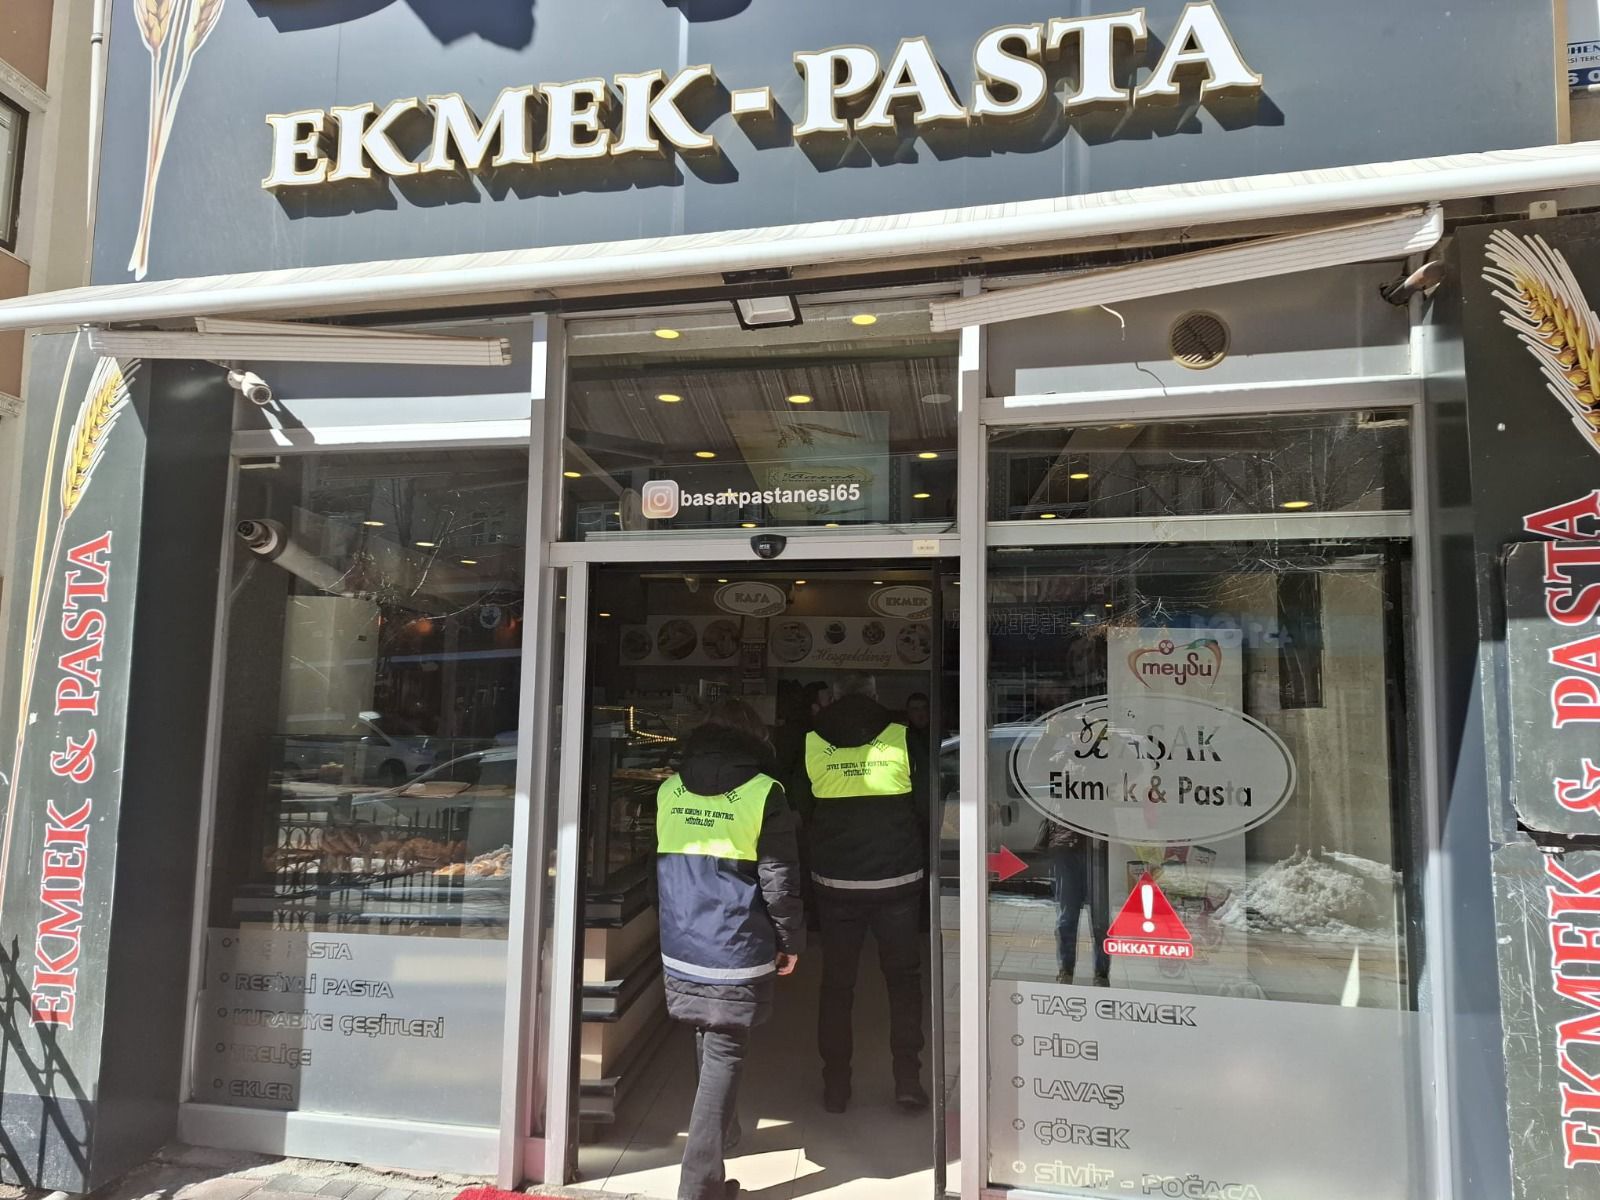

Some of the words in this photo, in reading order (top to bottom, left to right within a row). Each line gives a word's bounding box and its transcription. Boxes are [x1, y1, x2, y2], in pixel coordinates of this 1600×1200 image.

[261, 64, 714, 188] EKMEK
[793, 2, 1263, 137] PASTA
[681, 484, 860, 508] basakpastanesi65
[885, 596, 928, 607] EKMEK
[1522, 489, 1600, 729] PASTA
[54, 531, 112, 717] PASTA
[50, 729, 97, 784] &
[1147, 776, 1168, 804] &
[1178, 776, 1252, 807] Pasta
[29, 798, 92, 1031] EKMEK
[1108, 940, 1155, 955] DİKKAT
[1160, 944, 1189, 957] KAPI
[323, 978, 394, 999] PASTA
[232, 1007, 333, 1031] KURABİYE
[339, 1013, 444, 1039] ÇEŞİTLERİ
[1031, 994, 1087, 1022] TAŞ
[1095, 999, 1197, 1027] EKMEK
[1544, 854, 1600, 1169] EKMEK
[1033, 1033, 1098, 1061] PİDE
[229, 1080, 293, 1101] EKLER
[1033, 1078, 1124, 1110] LAVAŞ
[1034, 1118, 1130, 1149] ÇÖREK
[1034, 1160, 1114, 1190] SİMİT
